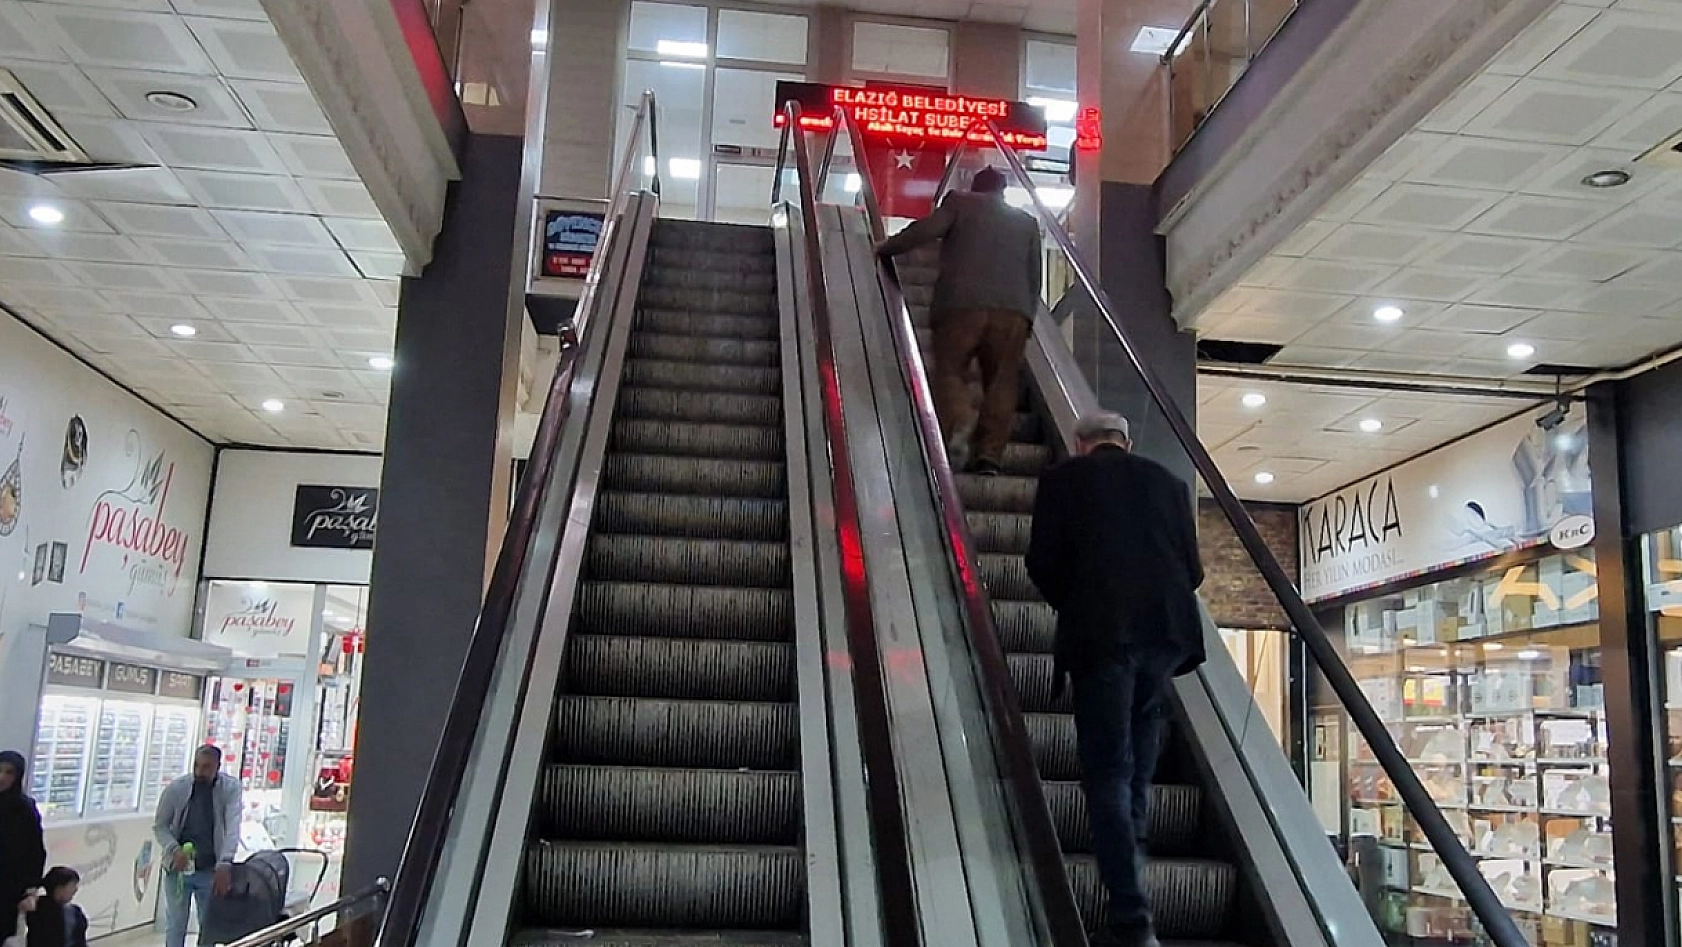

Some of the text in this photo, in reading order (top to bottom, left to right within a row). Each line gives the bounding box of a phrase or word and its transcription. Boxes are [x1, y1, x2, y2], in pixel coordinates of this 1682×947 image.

[833, 89, 1008, 117] ELAZIĞ BELEDİYESİ
[79, 461, 189, 598] paşabey
[1302, 475, 1402, 568] KARACA
[219, 600, 296, 636] paşabey
